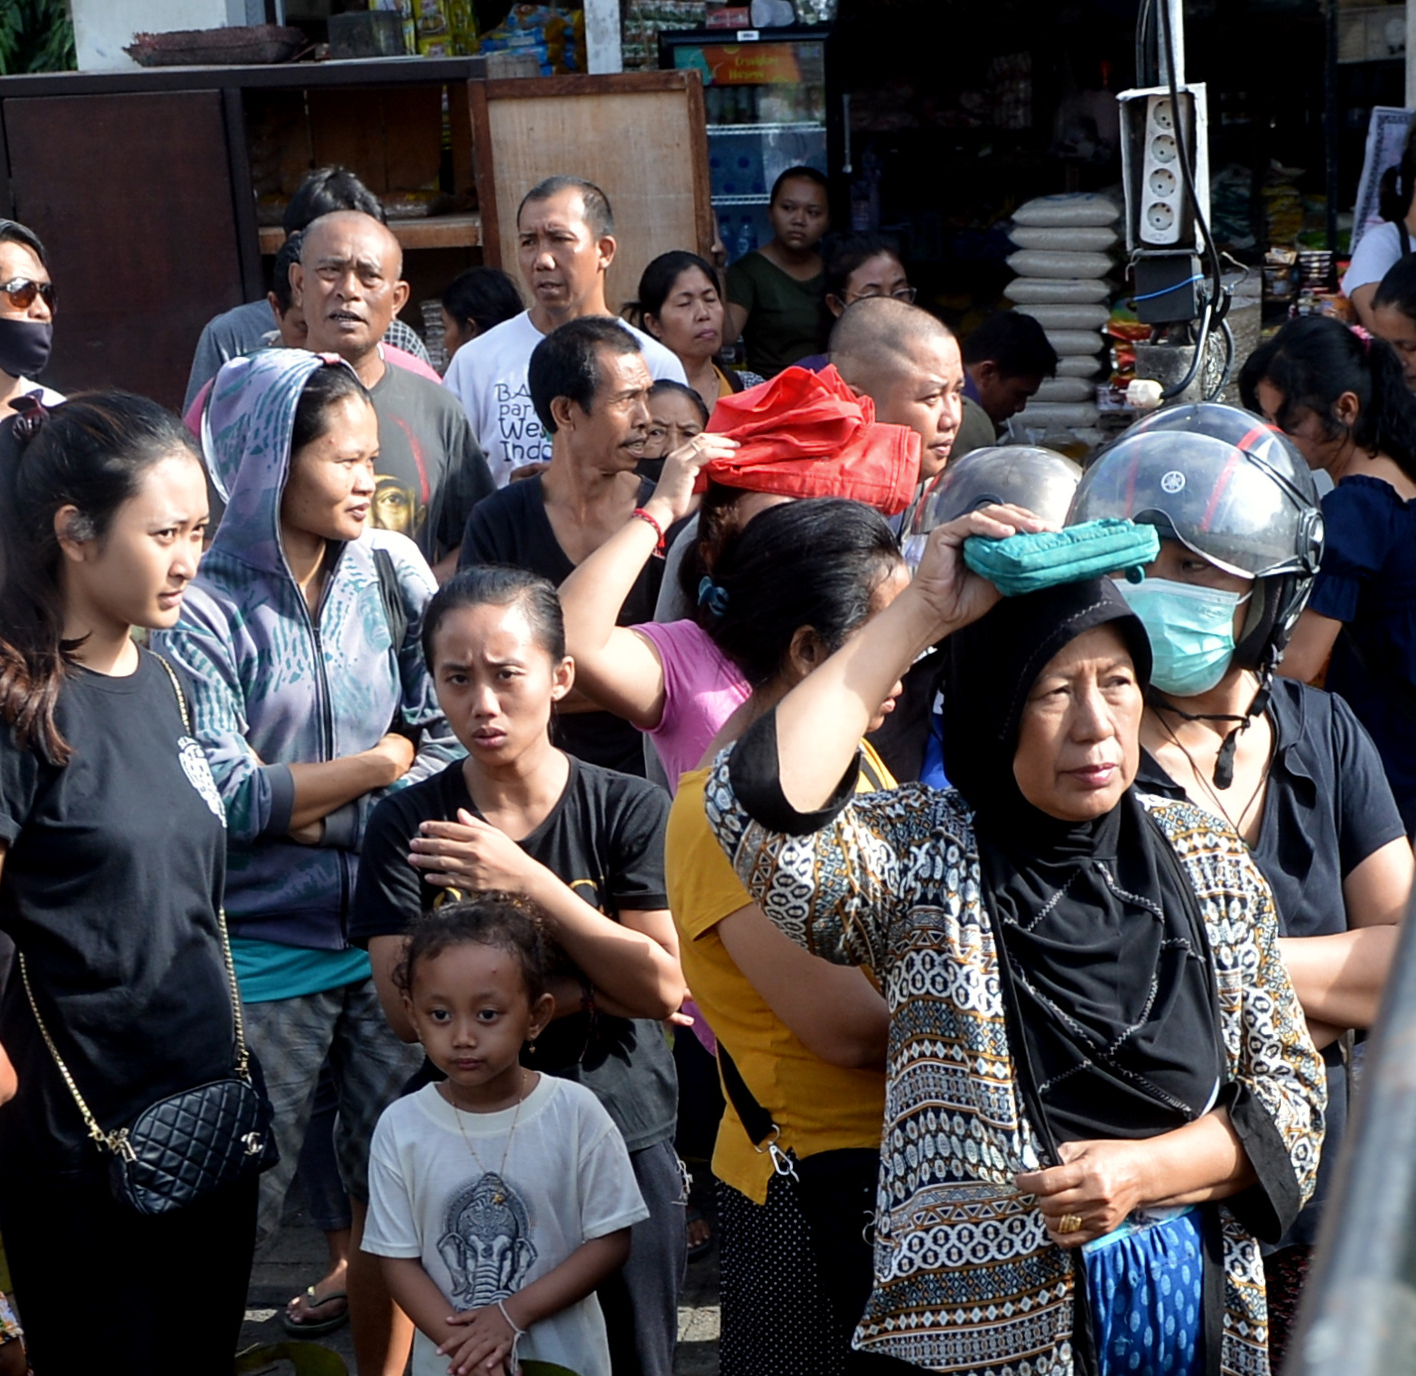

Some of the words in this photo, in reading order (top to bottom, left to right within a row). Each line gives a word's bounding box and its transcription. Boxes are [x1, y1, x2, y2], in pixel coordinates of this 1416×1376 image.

[494, 383, 531, 402] BA
[499, 403, 535, 420] par
[498, 417, 547, 440] Wes
[499, 440, 553, 462] Indo
